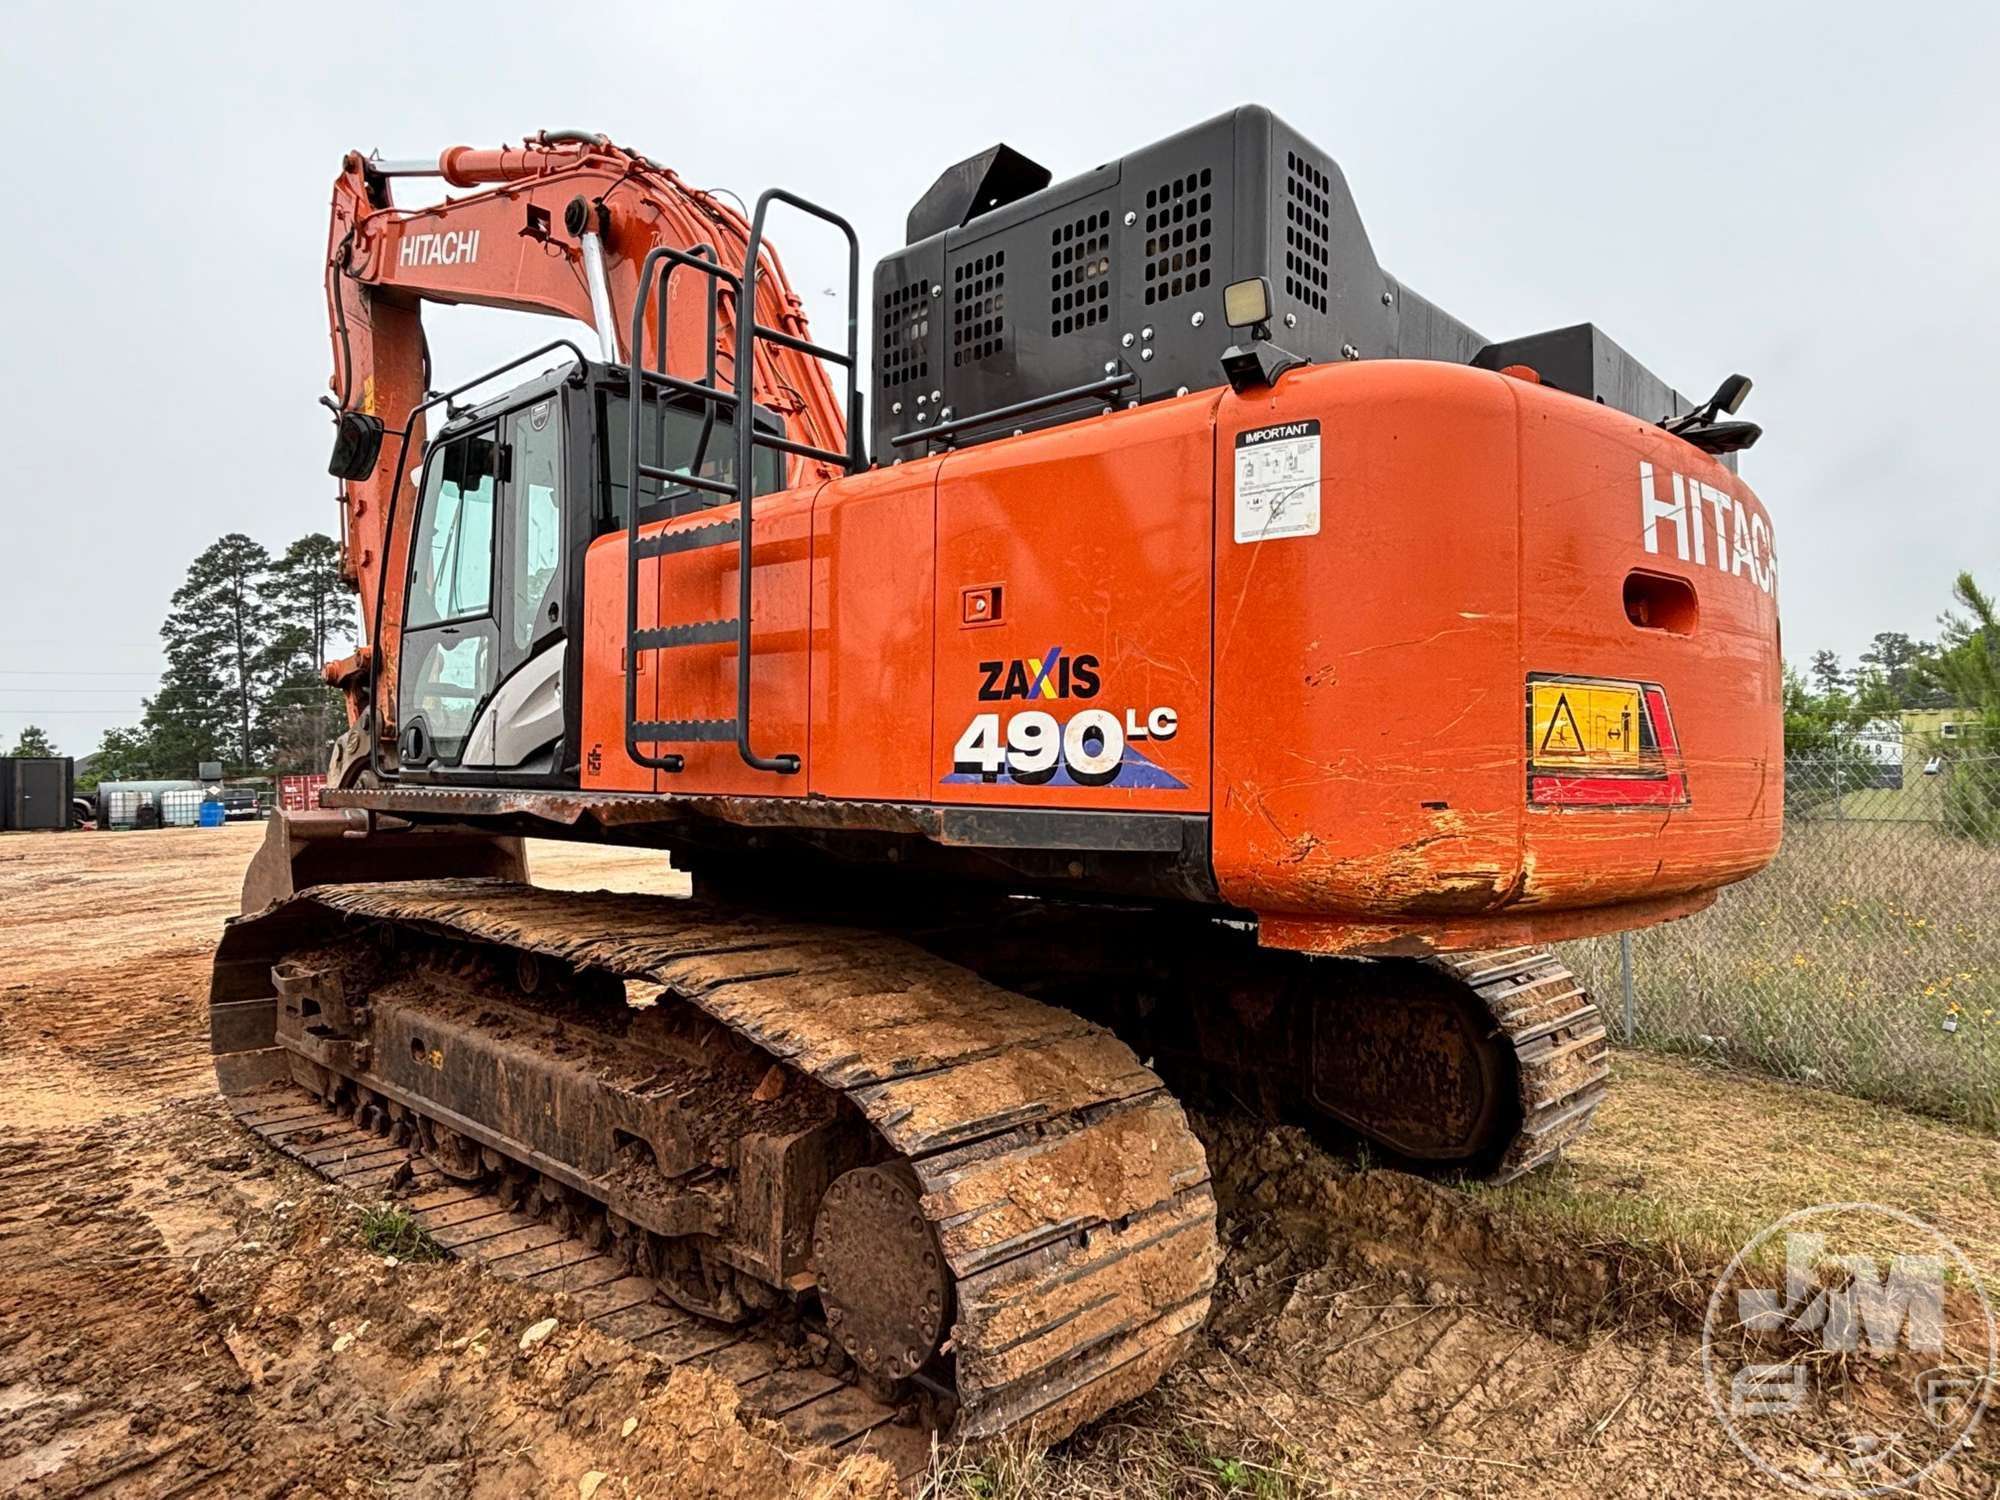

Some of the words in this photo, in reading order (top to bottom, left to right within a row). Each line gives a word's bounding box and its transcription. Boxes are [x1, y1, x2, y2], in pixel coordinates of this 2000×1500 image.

[399, 229, 481, 267] HITACHI
[1245, 423, 1309, 444] IMPORTANT
[978, 646, 1101, 702] ZAXIS
